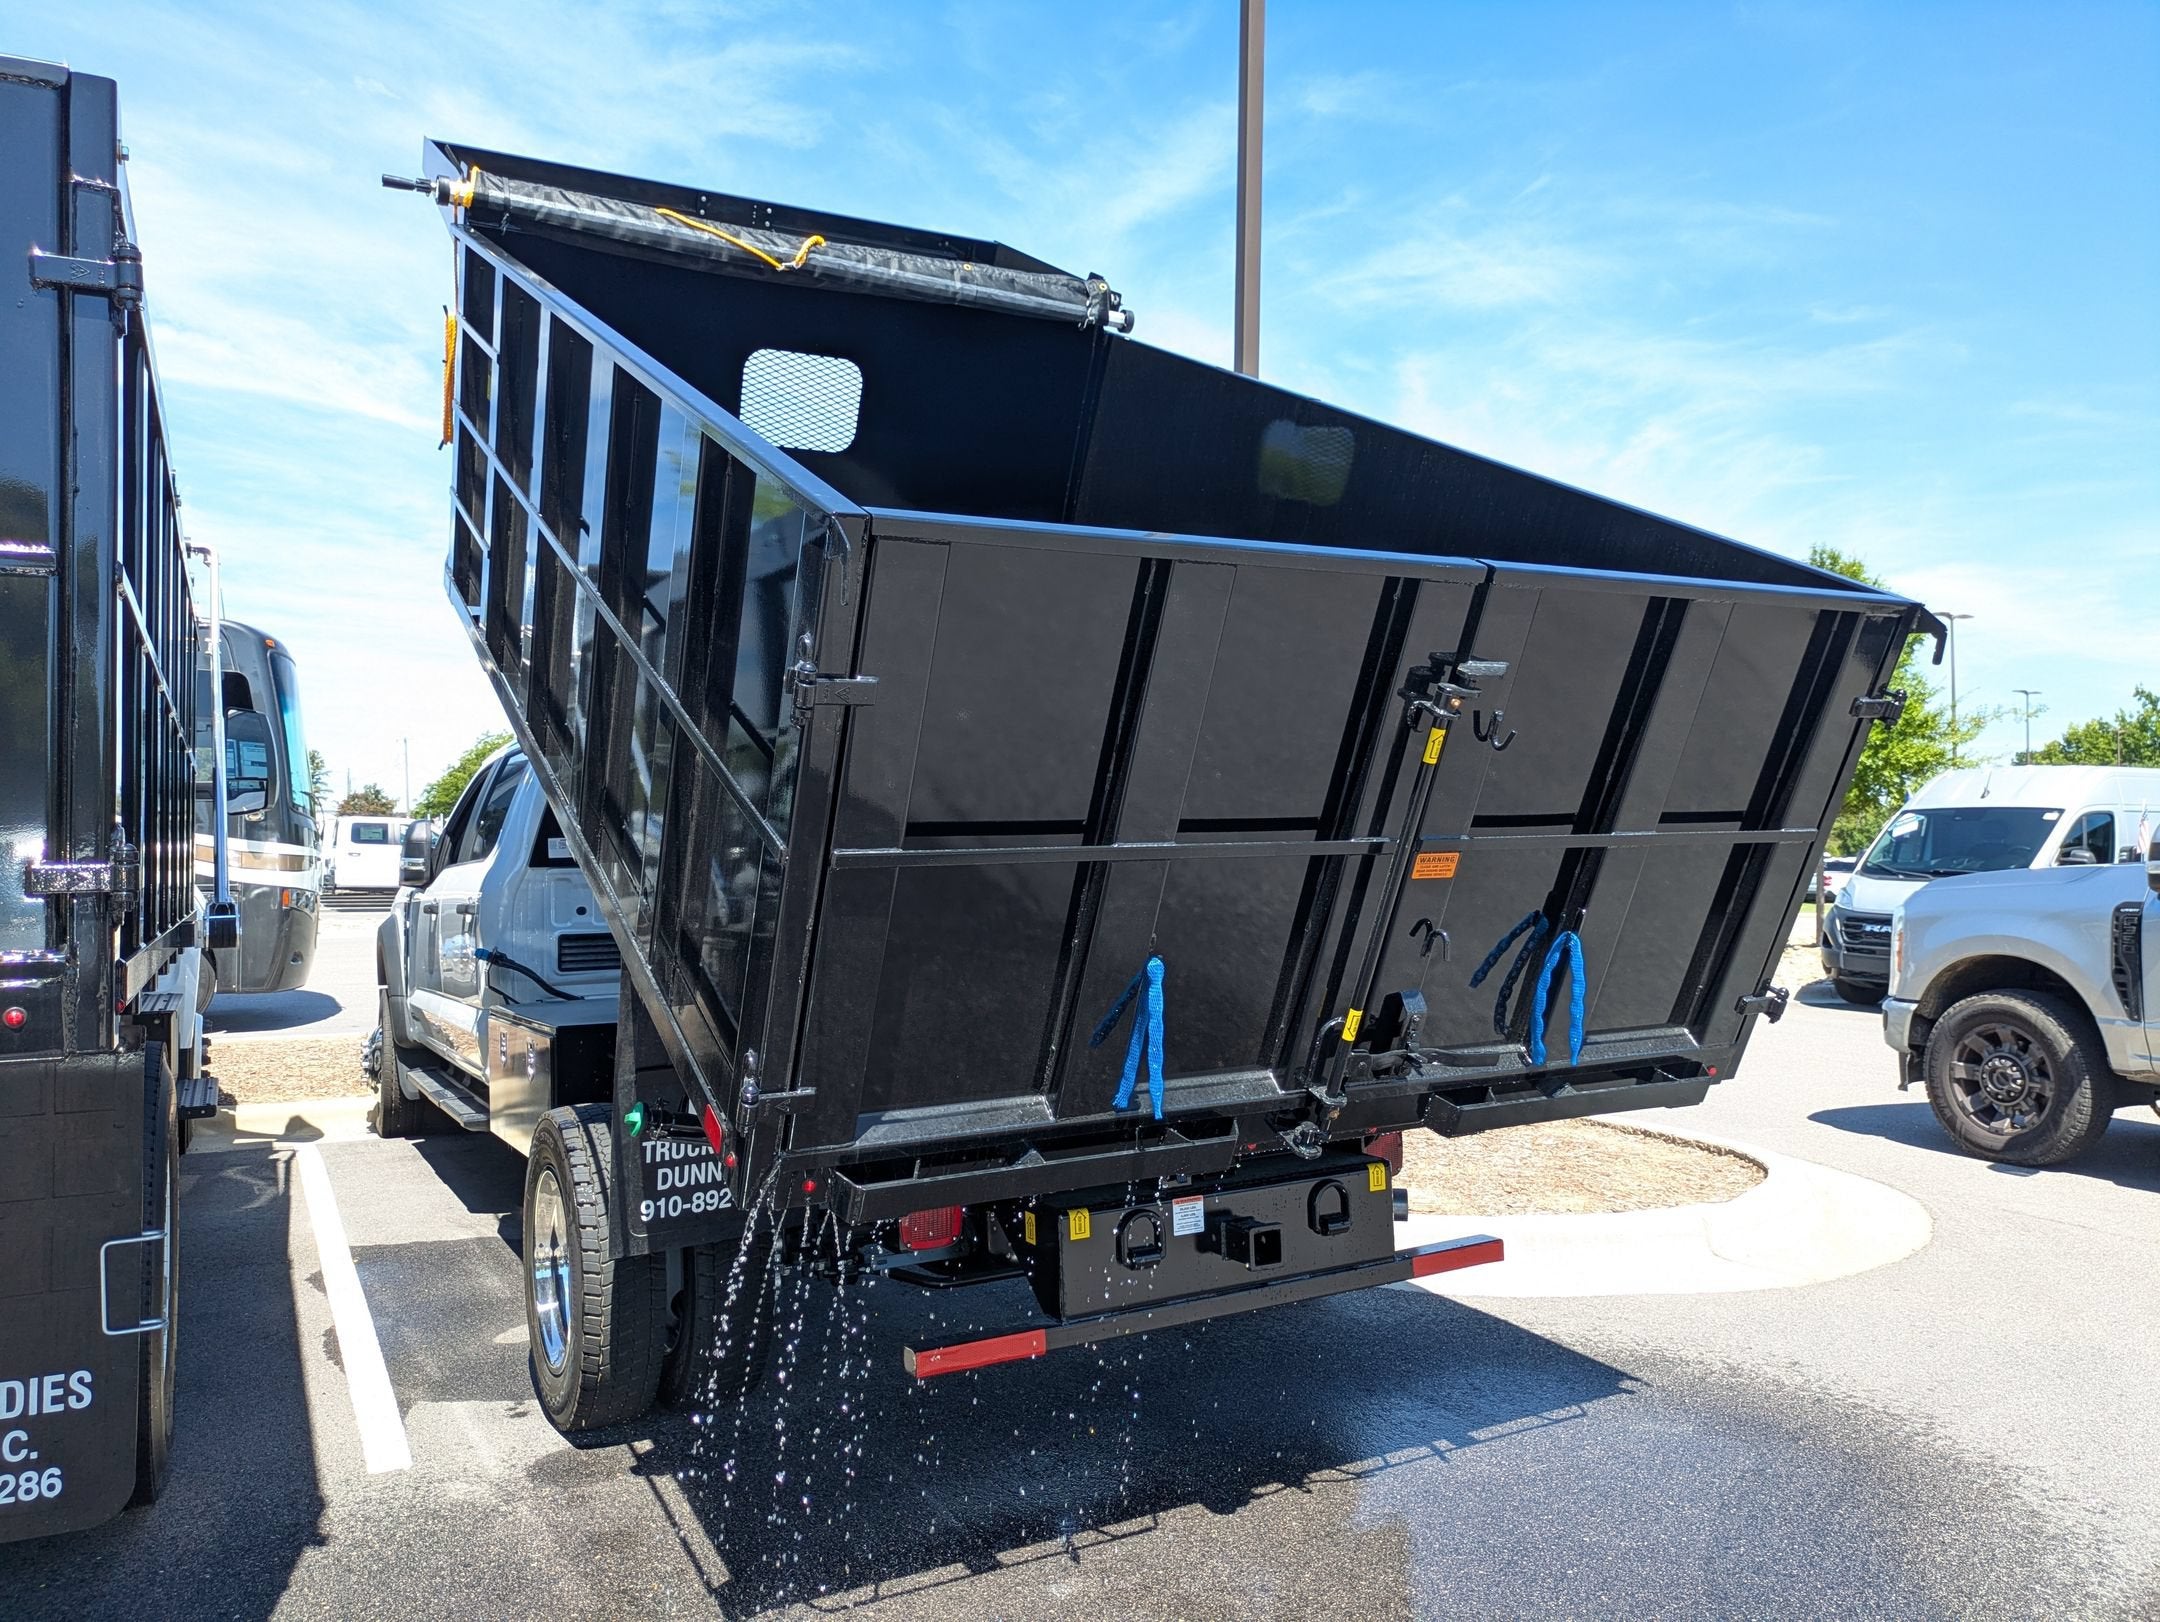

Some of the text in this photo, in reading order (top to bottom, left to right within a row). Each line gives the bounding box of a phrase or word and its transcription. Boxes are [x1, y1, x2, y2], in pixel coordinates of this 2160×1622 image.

[1864, 924, 1892, 932] RA
[0, 1370, 92, 1420] DIES
[2, 1430, 38, 1463] C.
[0, 1467, 62, 1504] 286
